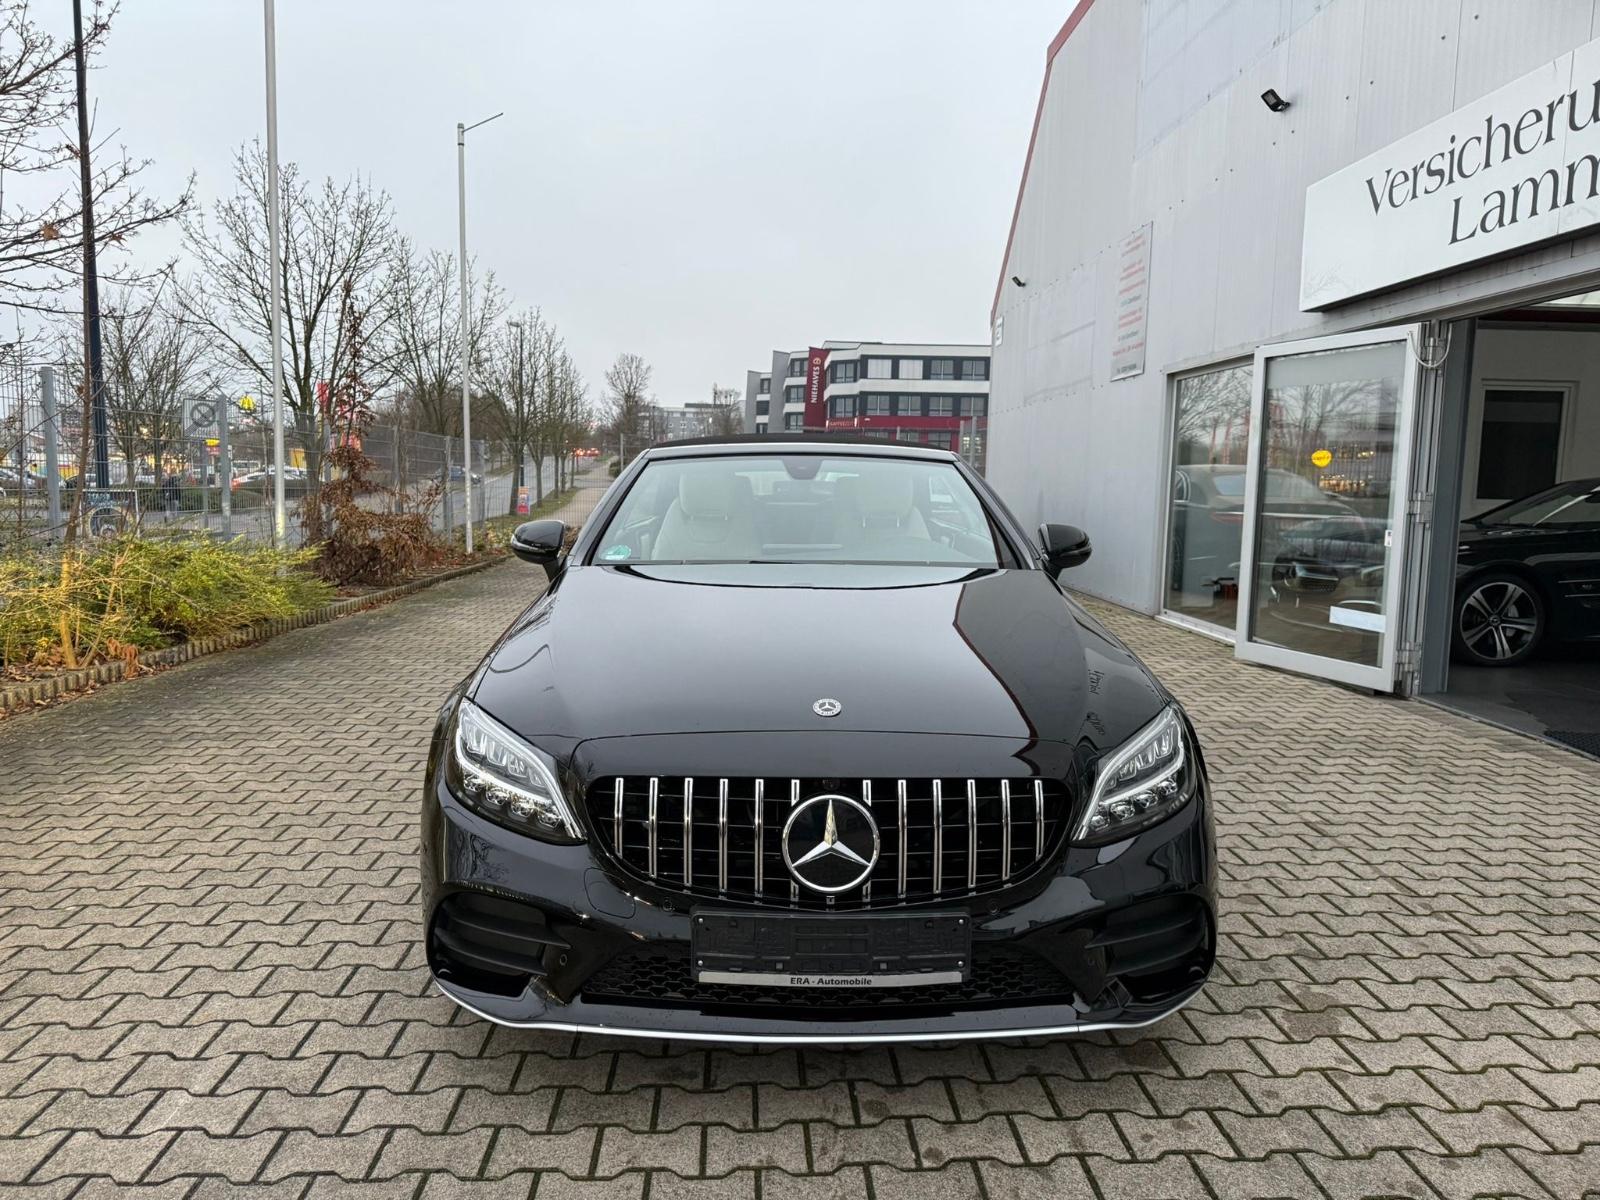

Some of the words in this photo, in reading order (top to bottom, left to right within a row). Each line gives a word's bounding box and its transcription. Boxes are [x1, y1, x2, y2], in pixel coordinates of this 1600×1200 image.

[811, 366, 820, 404] NIEHAVES
[790, 977, 810, 985] ERA
[817, 977, 872, 985] Automobile
